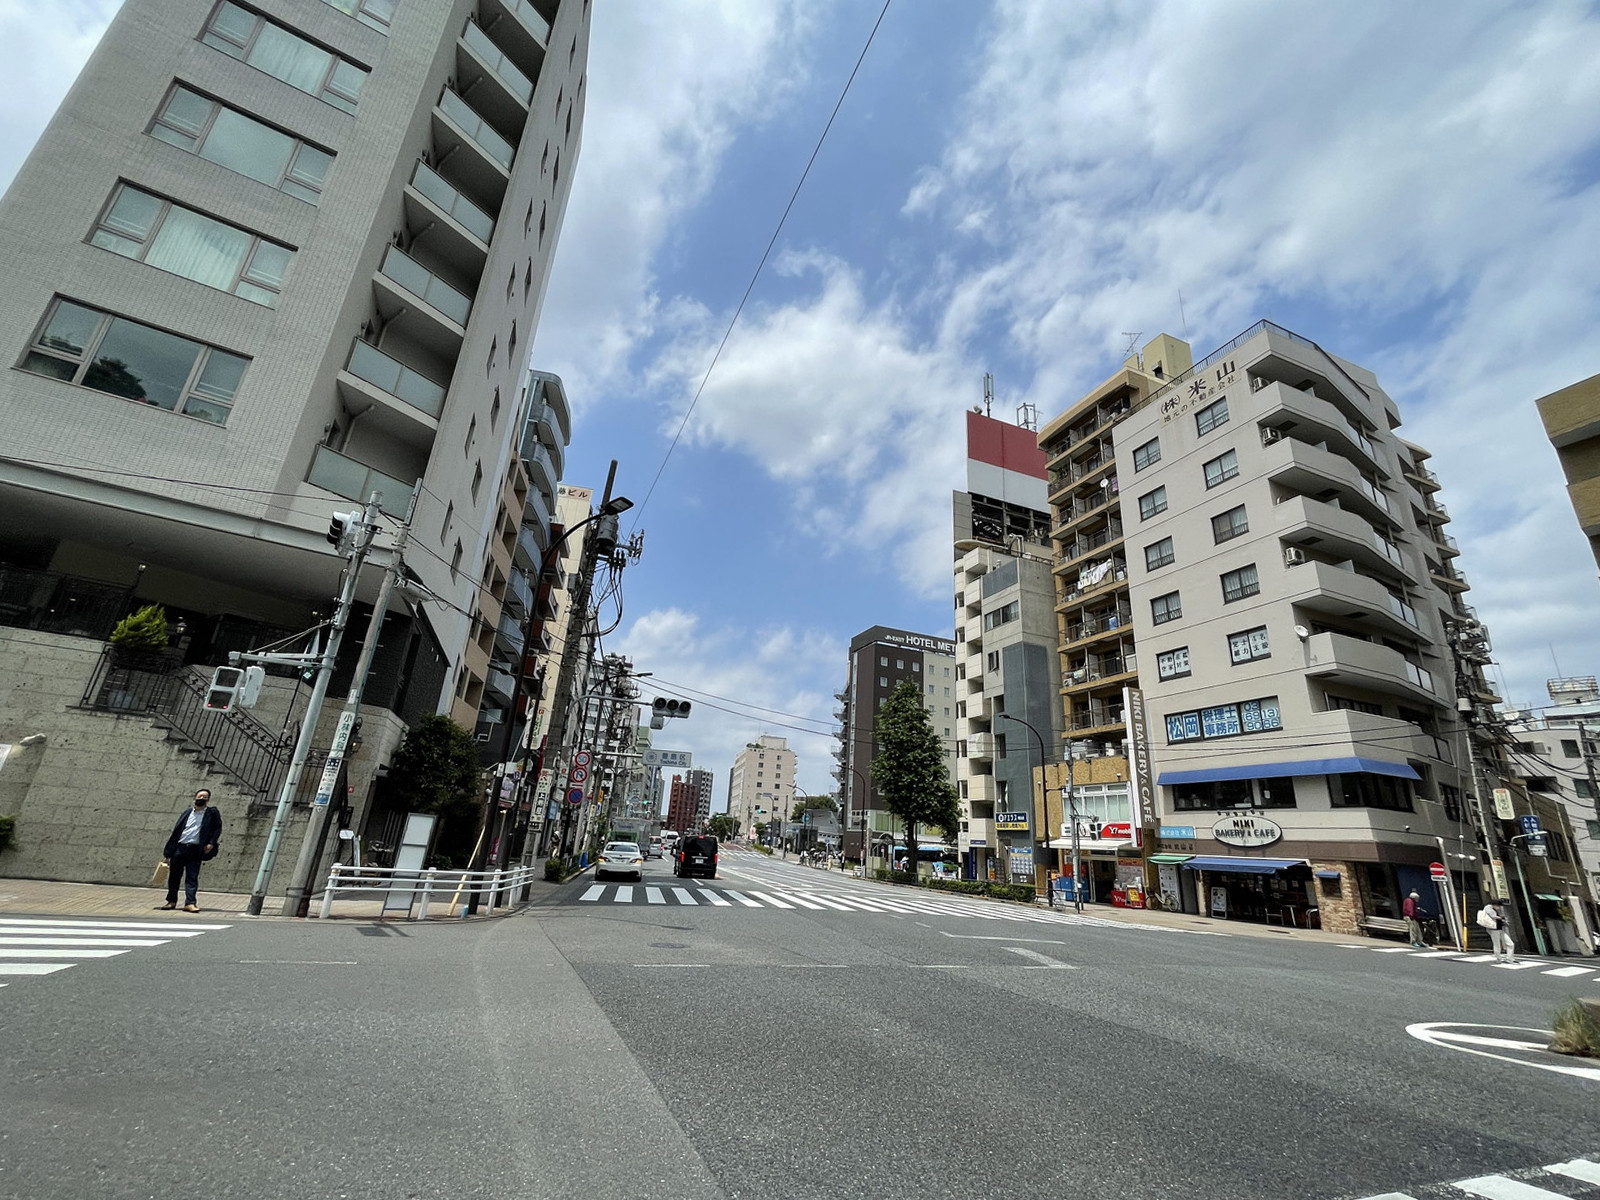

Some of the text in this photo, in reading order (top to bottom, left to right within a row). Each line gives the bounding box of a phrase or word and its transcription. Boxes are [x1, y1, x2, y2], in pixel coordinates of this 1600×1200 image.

[906, 635, 936, 649] HOTEL
[1132, 691, 1142, 721] NIKI
[1203, 706, 1236, 722] 税理士
[1244, 702, 1259, 712] 03
[1168, 714, 1199, 739] 松岡
[1204, 720, 1239, 736] 事務所
[1135, 723, 1148, 780] BAKERY
[1141, 787, 1155, 823] CAFÉ
[1232, 819, 1255, 830] NIKI
[1214, 828, 1246, 839] BAKERY
